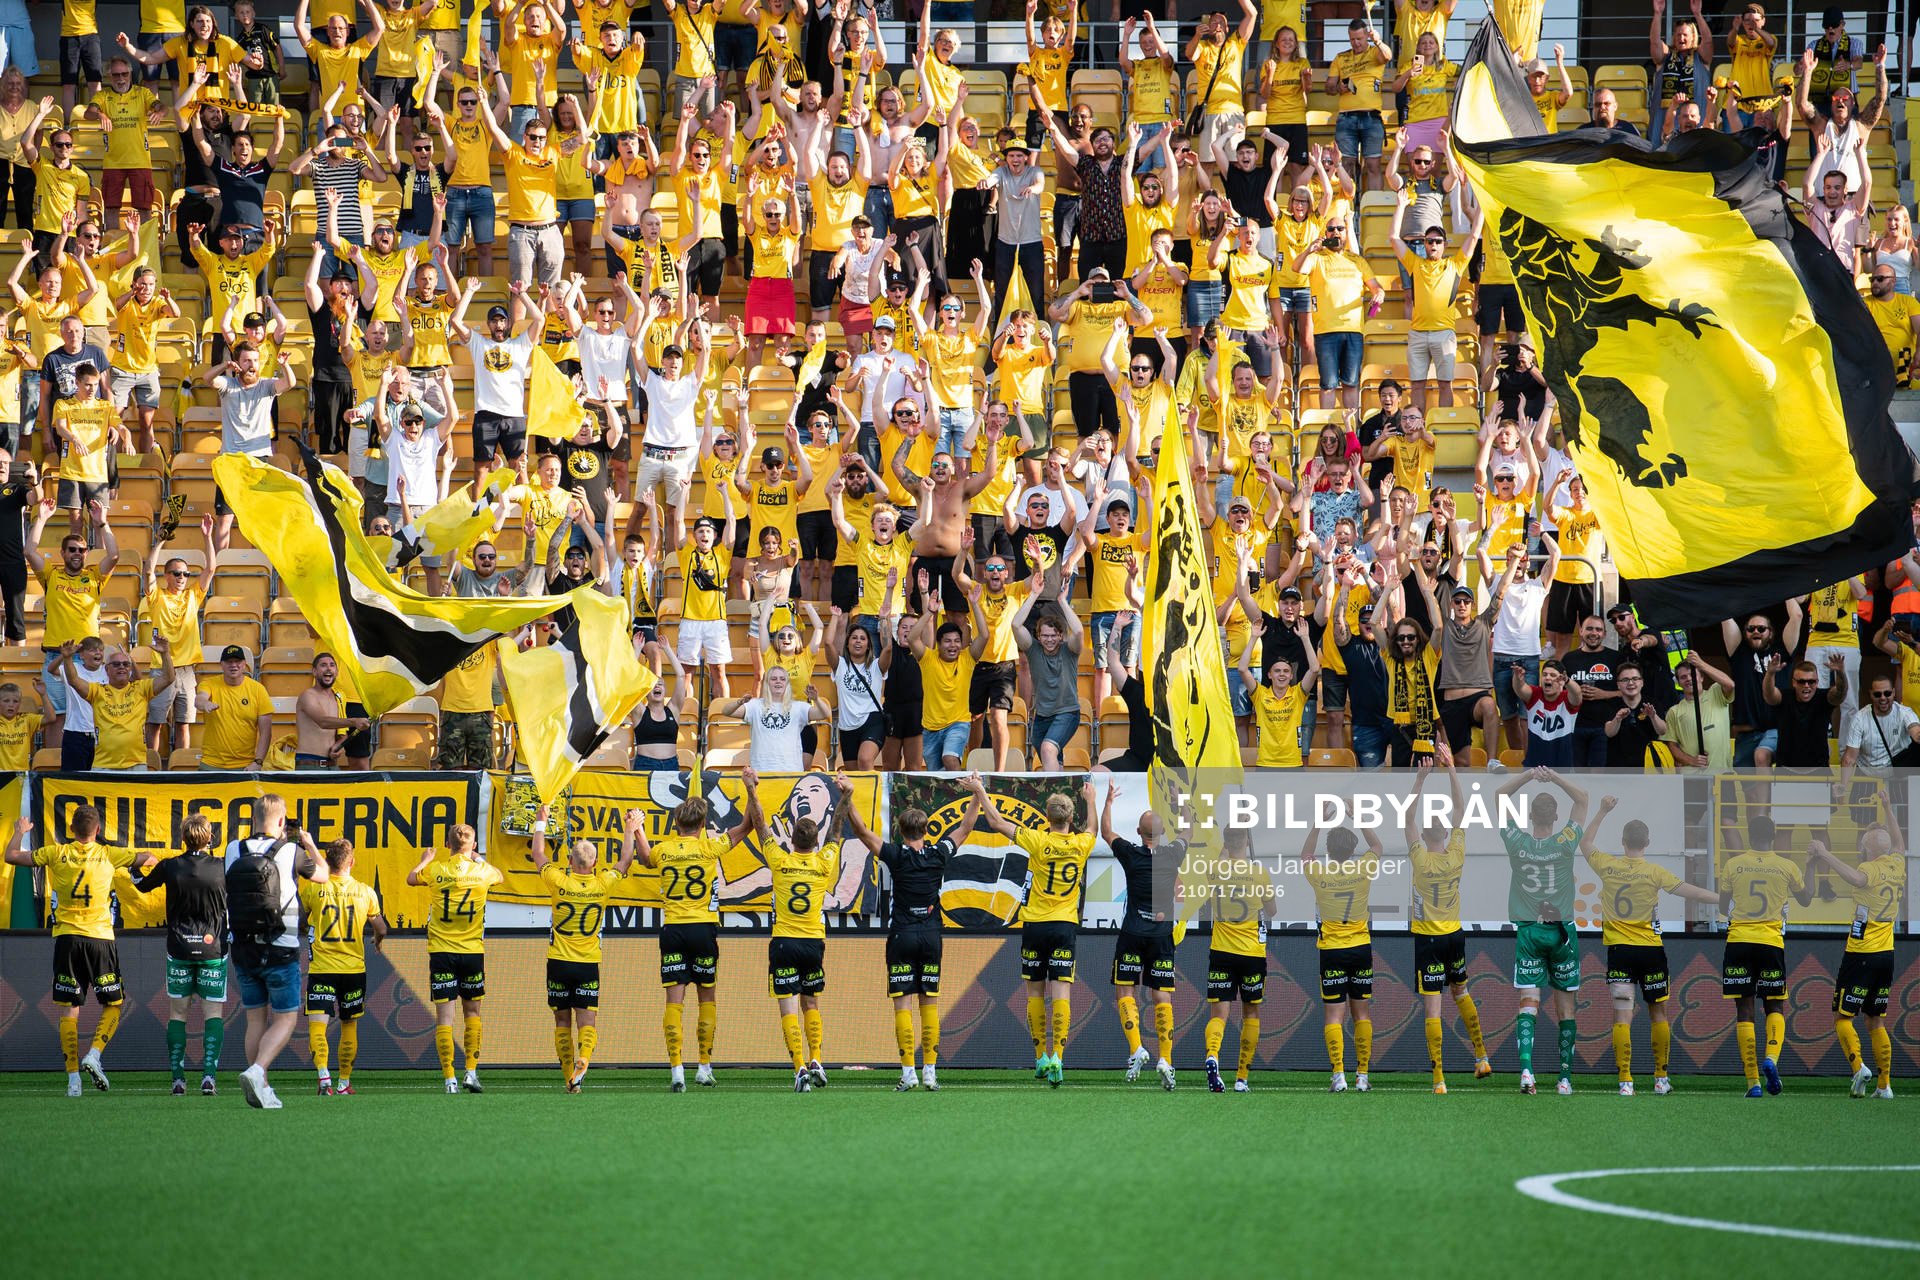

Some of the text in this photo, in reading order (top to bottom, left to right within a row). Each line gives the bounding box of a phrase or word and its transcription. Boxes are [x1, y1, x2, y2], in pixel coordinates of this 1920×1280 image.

[411, 313, 442, 330] ellos
[1571, 670, 1613, 681] ellesse
[1533, 709, 1565, 733] FILA
[54, 795, 457, 852] GULIGAERNA
[569, 805, 681, 835] SVATA
[71, 869, 93, 908] 4
[661, 865, 707, 900] 28
[1043, 861, 1079, 896] 19
[1521, 863, 1558, 896] 31
[439, 887, 476, 924] 14
[788, 882, 811, 915] 8
[1214, 888, 1249, 923] 15
[1333, 891, 1355, 925] 7
[1614, 884, 1633, 918] 6
[1747, 880, 1768, 918] 5
[320, 904, 357, 943] 21
[555, 901, 602, 937] 20
